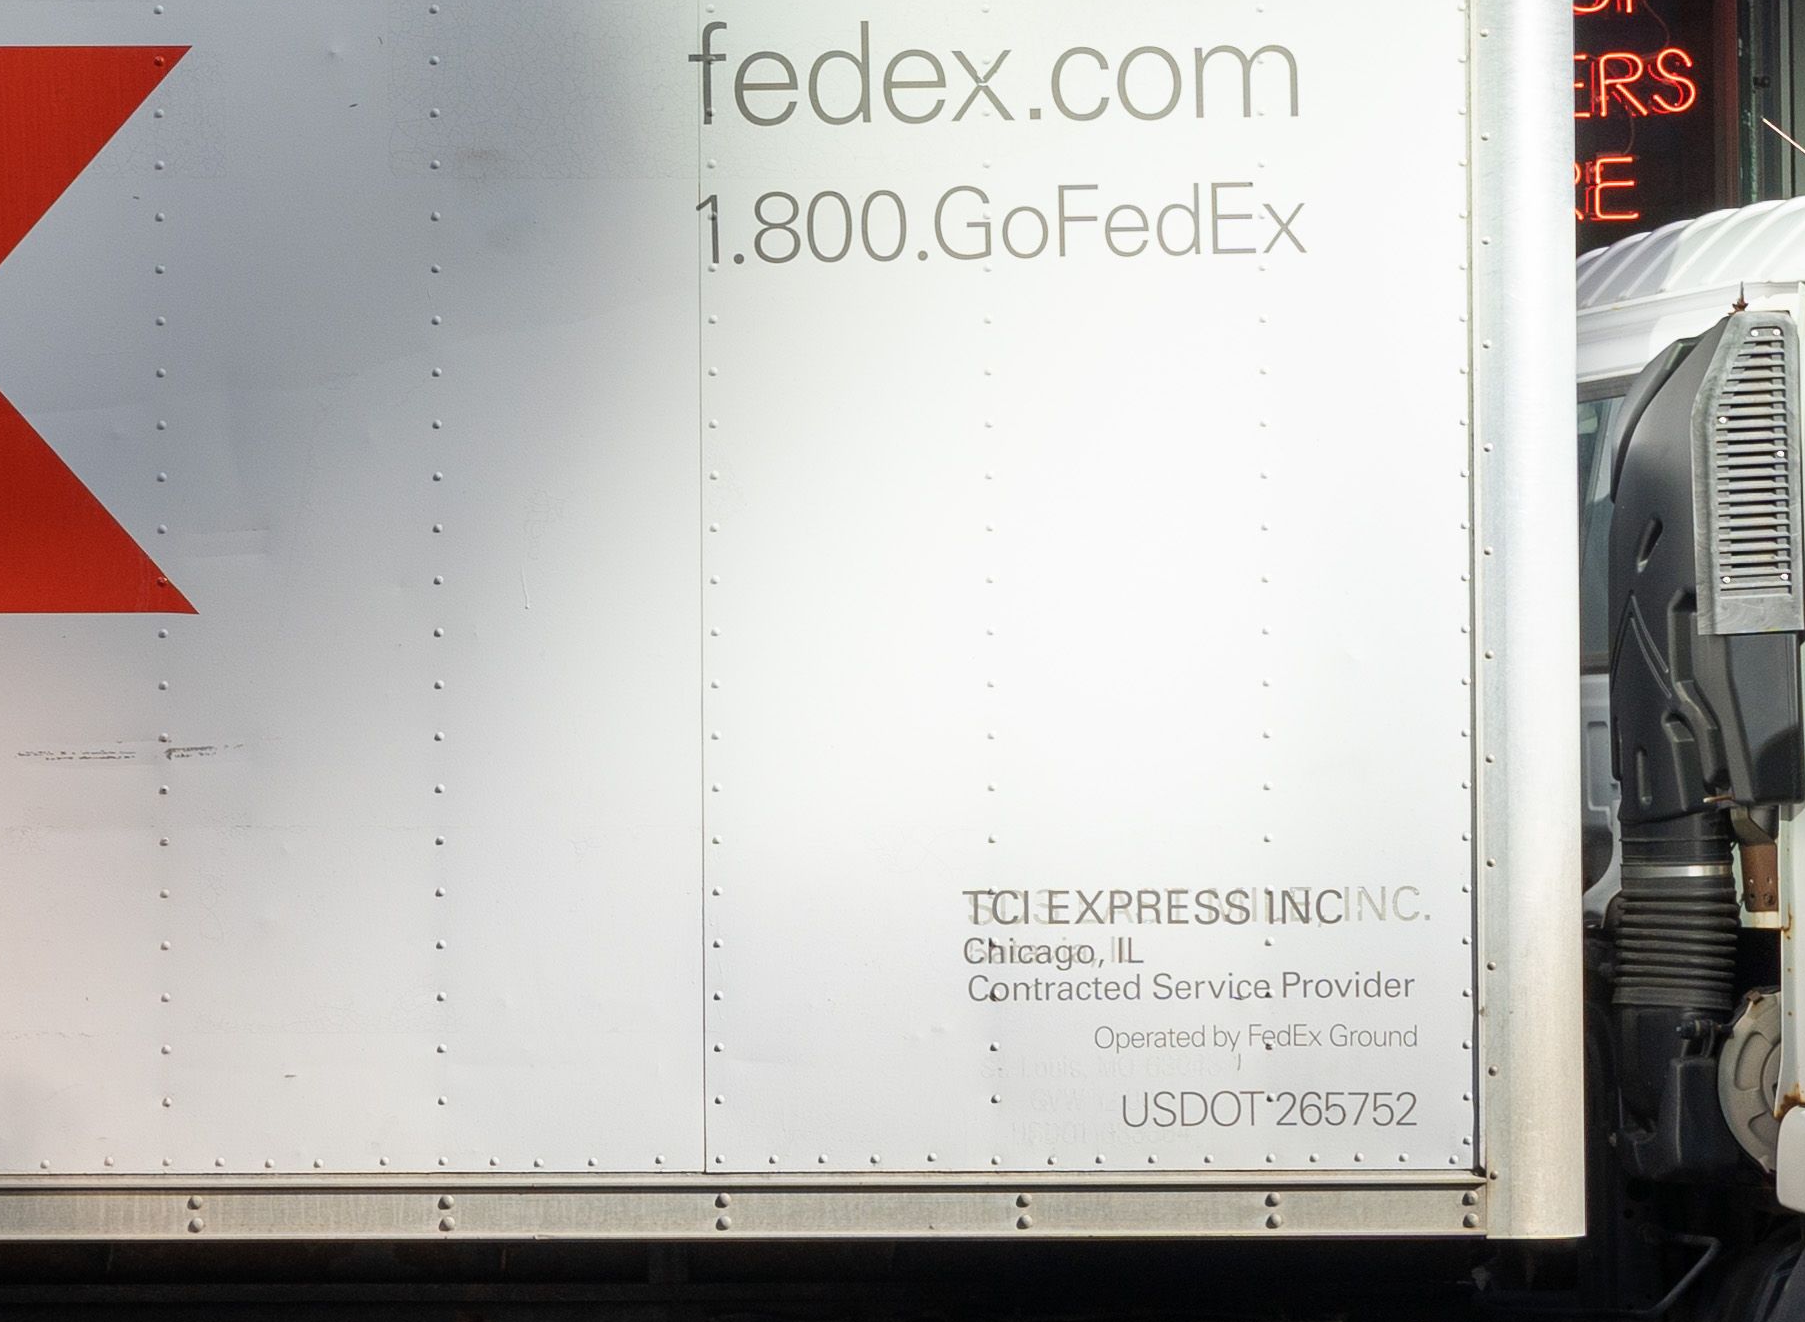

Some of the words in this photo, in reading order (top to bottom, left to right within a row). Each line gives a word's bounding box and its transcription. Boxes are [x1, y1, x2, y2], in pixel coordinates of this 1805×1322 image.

[687, 19, 1300, 127] fedex.com
[694, 181, 1308, 265] 1.800.GoFedEx
[962, 889, 1030, 925] TCI
[1046, 888, 1251, 926] EXPRESS
[963, 935, 1104, 970] Chicago,
[1117, 936, 1144, 964] IL
[967, 974, 1142, 1002] Contracted
[1152, 972, 1271, 1000] Service
[1281, 969, 1416, 999] Provider
[1093, 1025, 1205, 1050] Operated
[1212, 1024, 1242, 1052] by
[1248, 1024, 1323, 1049] FedEx
[1329, 1023, 1418, 1048] Ground
[1122, 1091, 1266, 1128] USDOT
[1275, 1090, 1418, 1127] 265752
